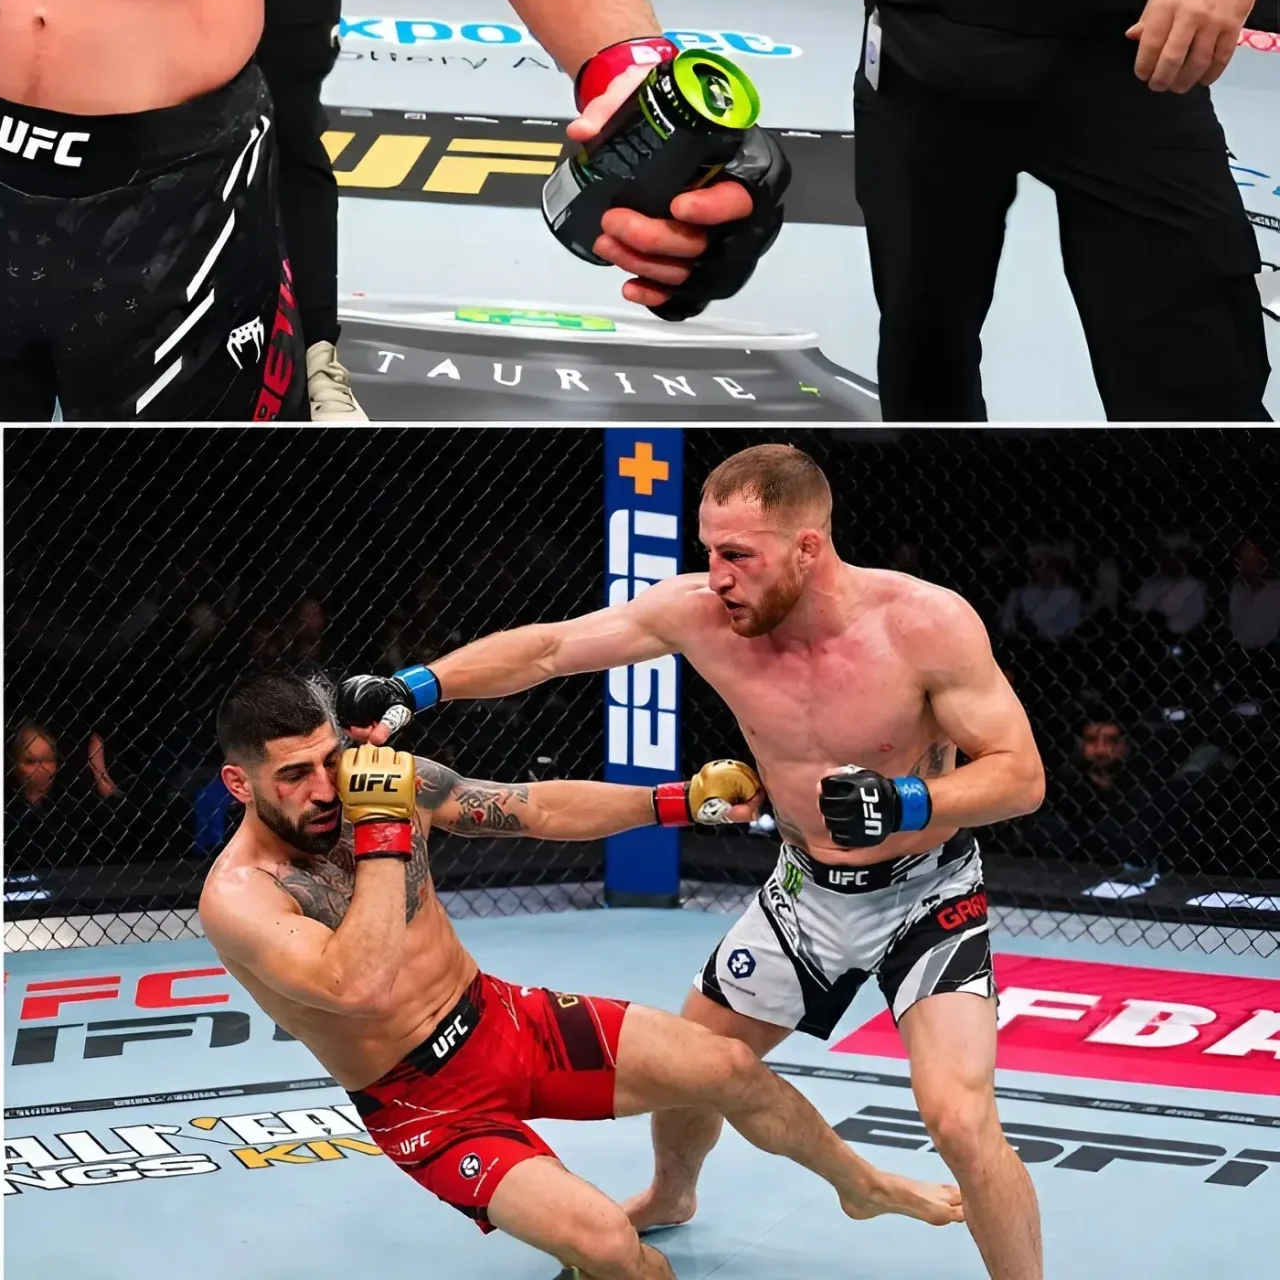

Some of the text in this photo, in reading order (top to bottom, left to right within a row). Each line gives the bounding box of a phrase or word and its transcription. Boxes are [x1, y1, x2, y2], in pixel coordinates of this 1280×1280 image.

[319, 130, 564, 194] UF
[377, 350, 757, 401] TAURINE
[349, 773, 401, 793] UFC
[860, 787, 881, 836] UFC
[829, 869, 869, 886] UFC
[4, 967, 230, 1020] FC
[431, 1014, 468, 1059] UFC
[400, 1130, 432, 1155] UFC
